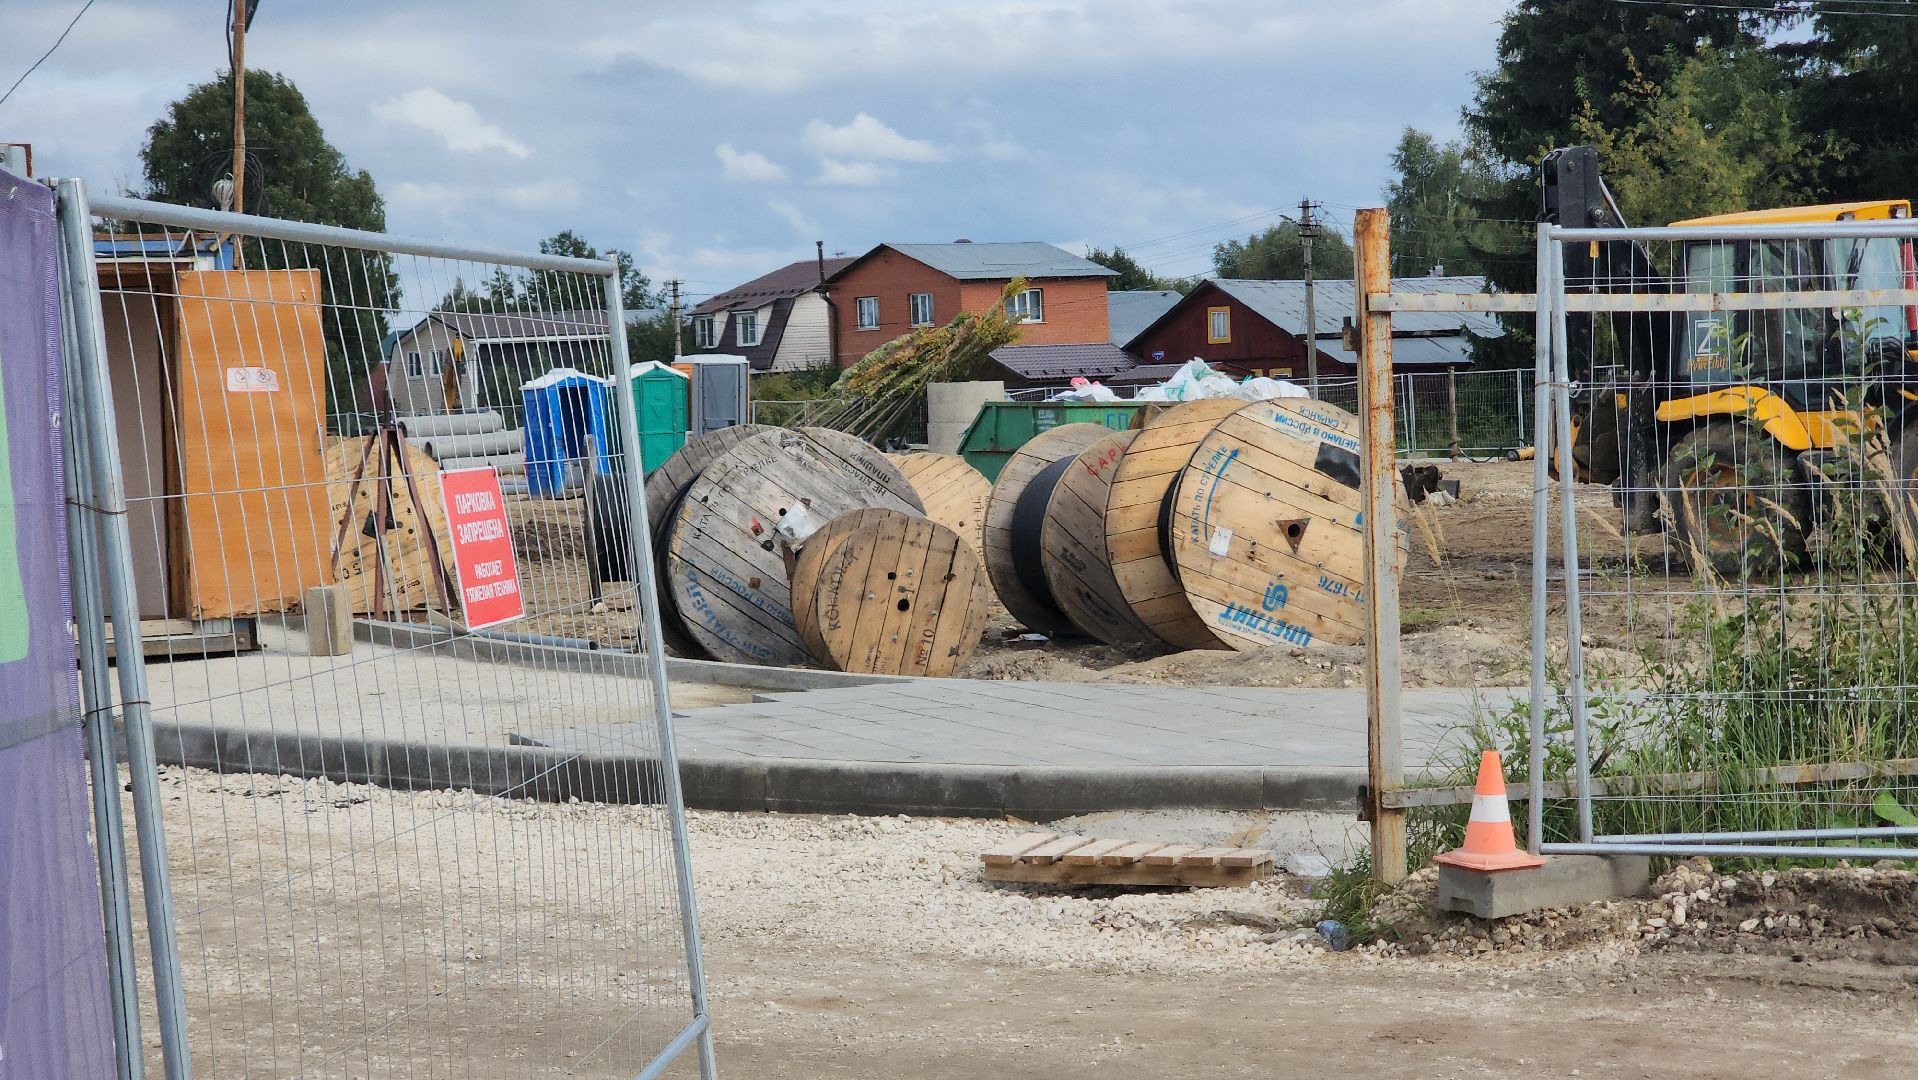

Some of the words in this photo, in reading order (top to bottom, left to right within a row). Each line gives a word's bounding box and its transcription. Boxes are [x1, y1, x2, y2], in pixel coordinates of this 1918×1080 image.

[1275, 413, 1312, 433] РОССИИ
[1299, 406, 1339, 427] САРАНСК
[1200, 446, 1228, 487] СТРЕЛКЕ
[872, 483, 888, 497] НЕ
[1194, 488, 1205, 504] ПО
[455, 491, 496, 515] ПАРКОВКА
[457, 518, 504, 544] ЗАПРЕЩЕНА
[1190, 504, 1201, 543] КАТАТЬ
[474, 559, 503, 579] РАБОТАЕТ
[466, 584, 494, 603] ТЯЖЕЛАЯ
[494, 578, 517, 597] ТЕХНИКА
[1219, 601, 1313, 648] ЦВЕТЛИТ
